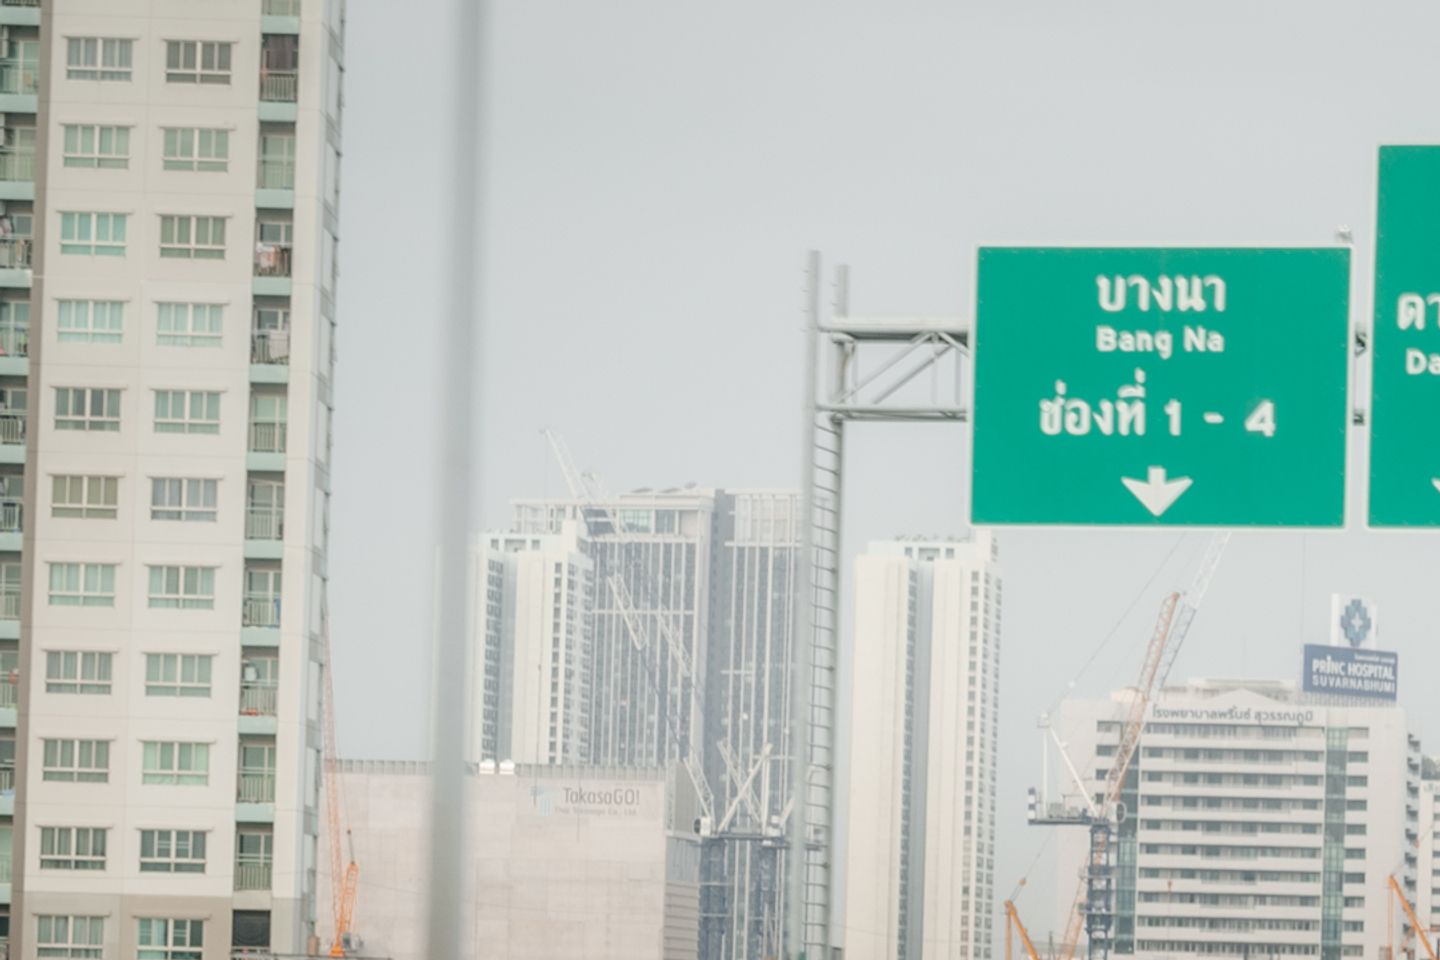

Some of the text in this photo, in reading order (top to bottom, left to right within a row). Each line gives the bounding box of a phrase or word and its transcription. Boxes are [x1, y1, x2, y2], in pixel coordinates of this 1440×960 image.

[1097, 275, 1226, 312] บางนา
[1097, 326, 1225, 360] Bang Na
[1039, 368, 1276, 437] ช่องที่ 1 - 4
[1312, 675, 1395, 693] SUVARNABHUMI
[1347, 662, 1395, 680] HOSPITAL
[562, 786, 640, 806] TakasaGO!
